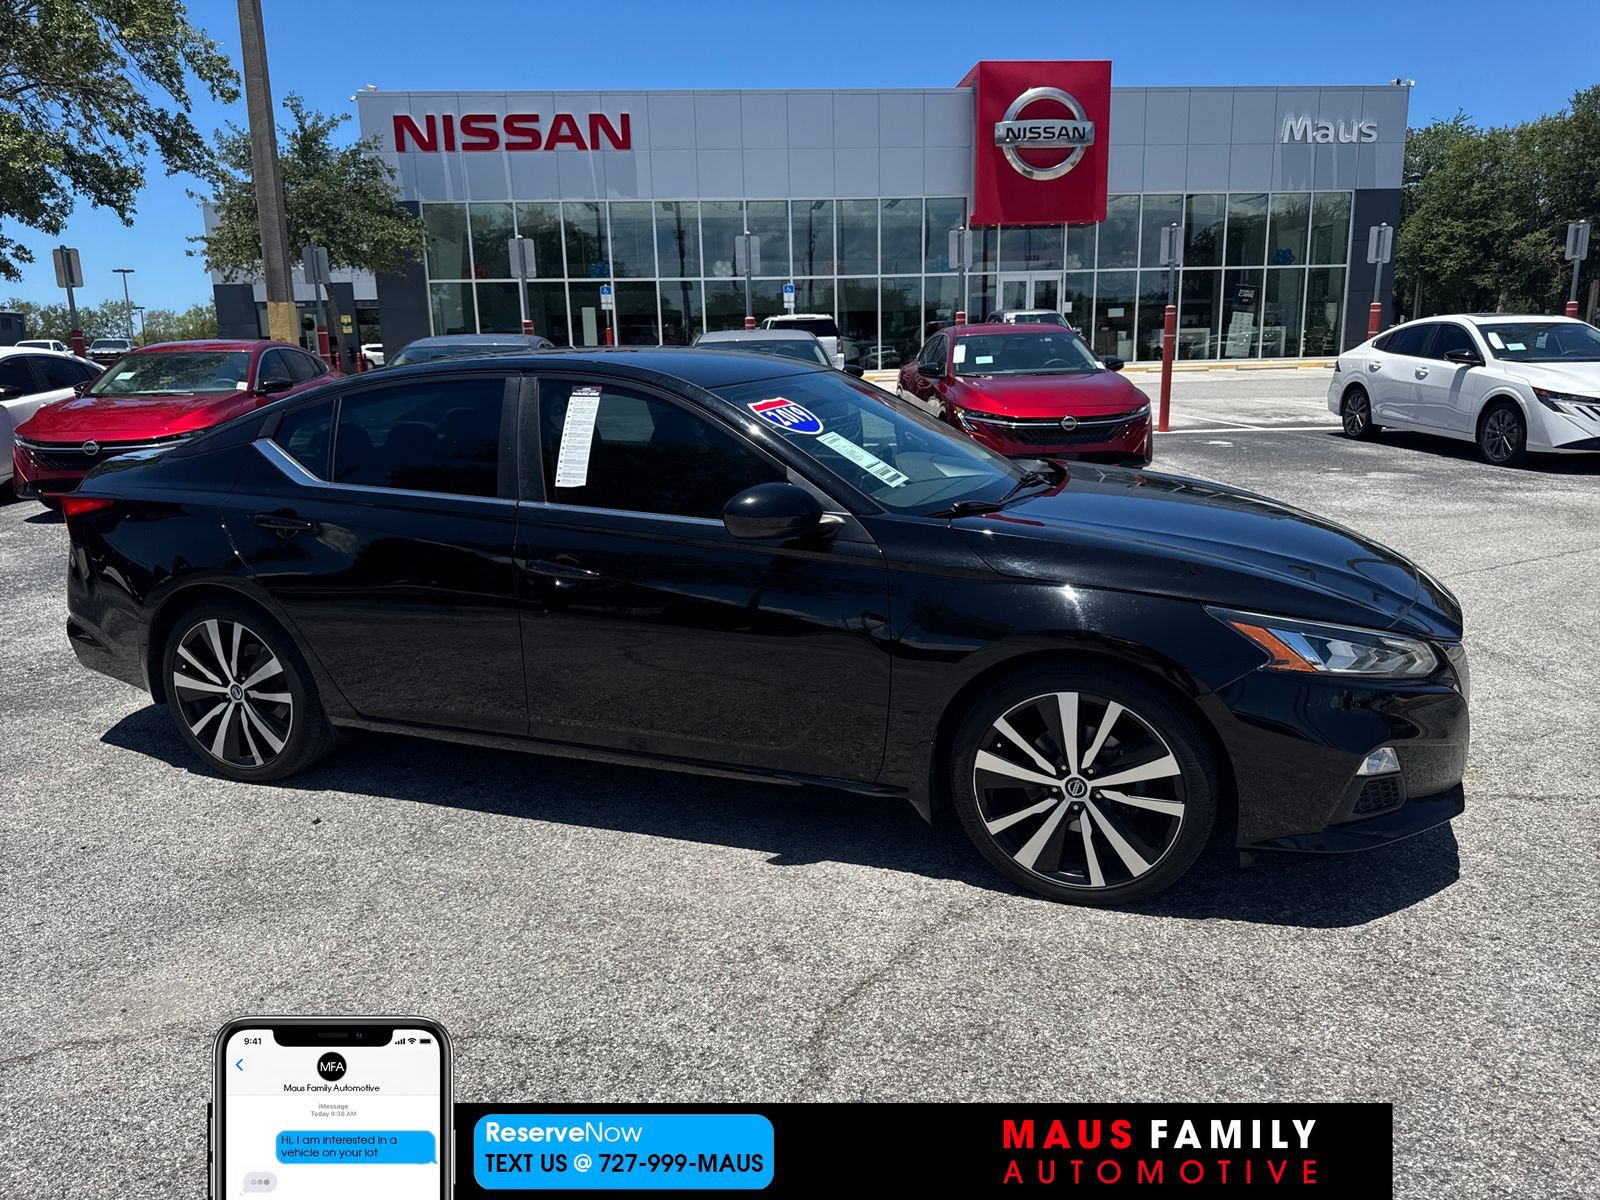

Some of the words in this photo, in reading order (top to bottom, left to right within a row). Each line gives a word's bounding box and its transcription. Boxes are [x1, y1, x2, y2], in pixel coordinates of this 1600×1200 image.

[393, 113, 632, 152] NISSAN
[1006, 126, 1086, 140] NISSAN
[1281, 115, 1378, 144] Maus
[766, 406, 813, 427] 2019
